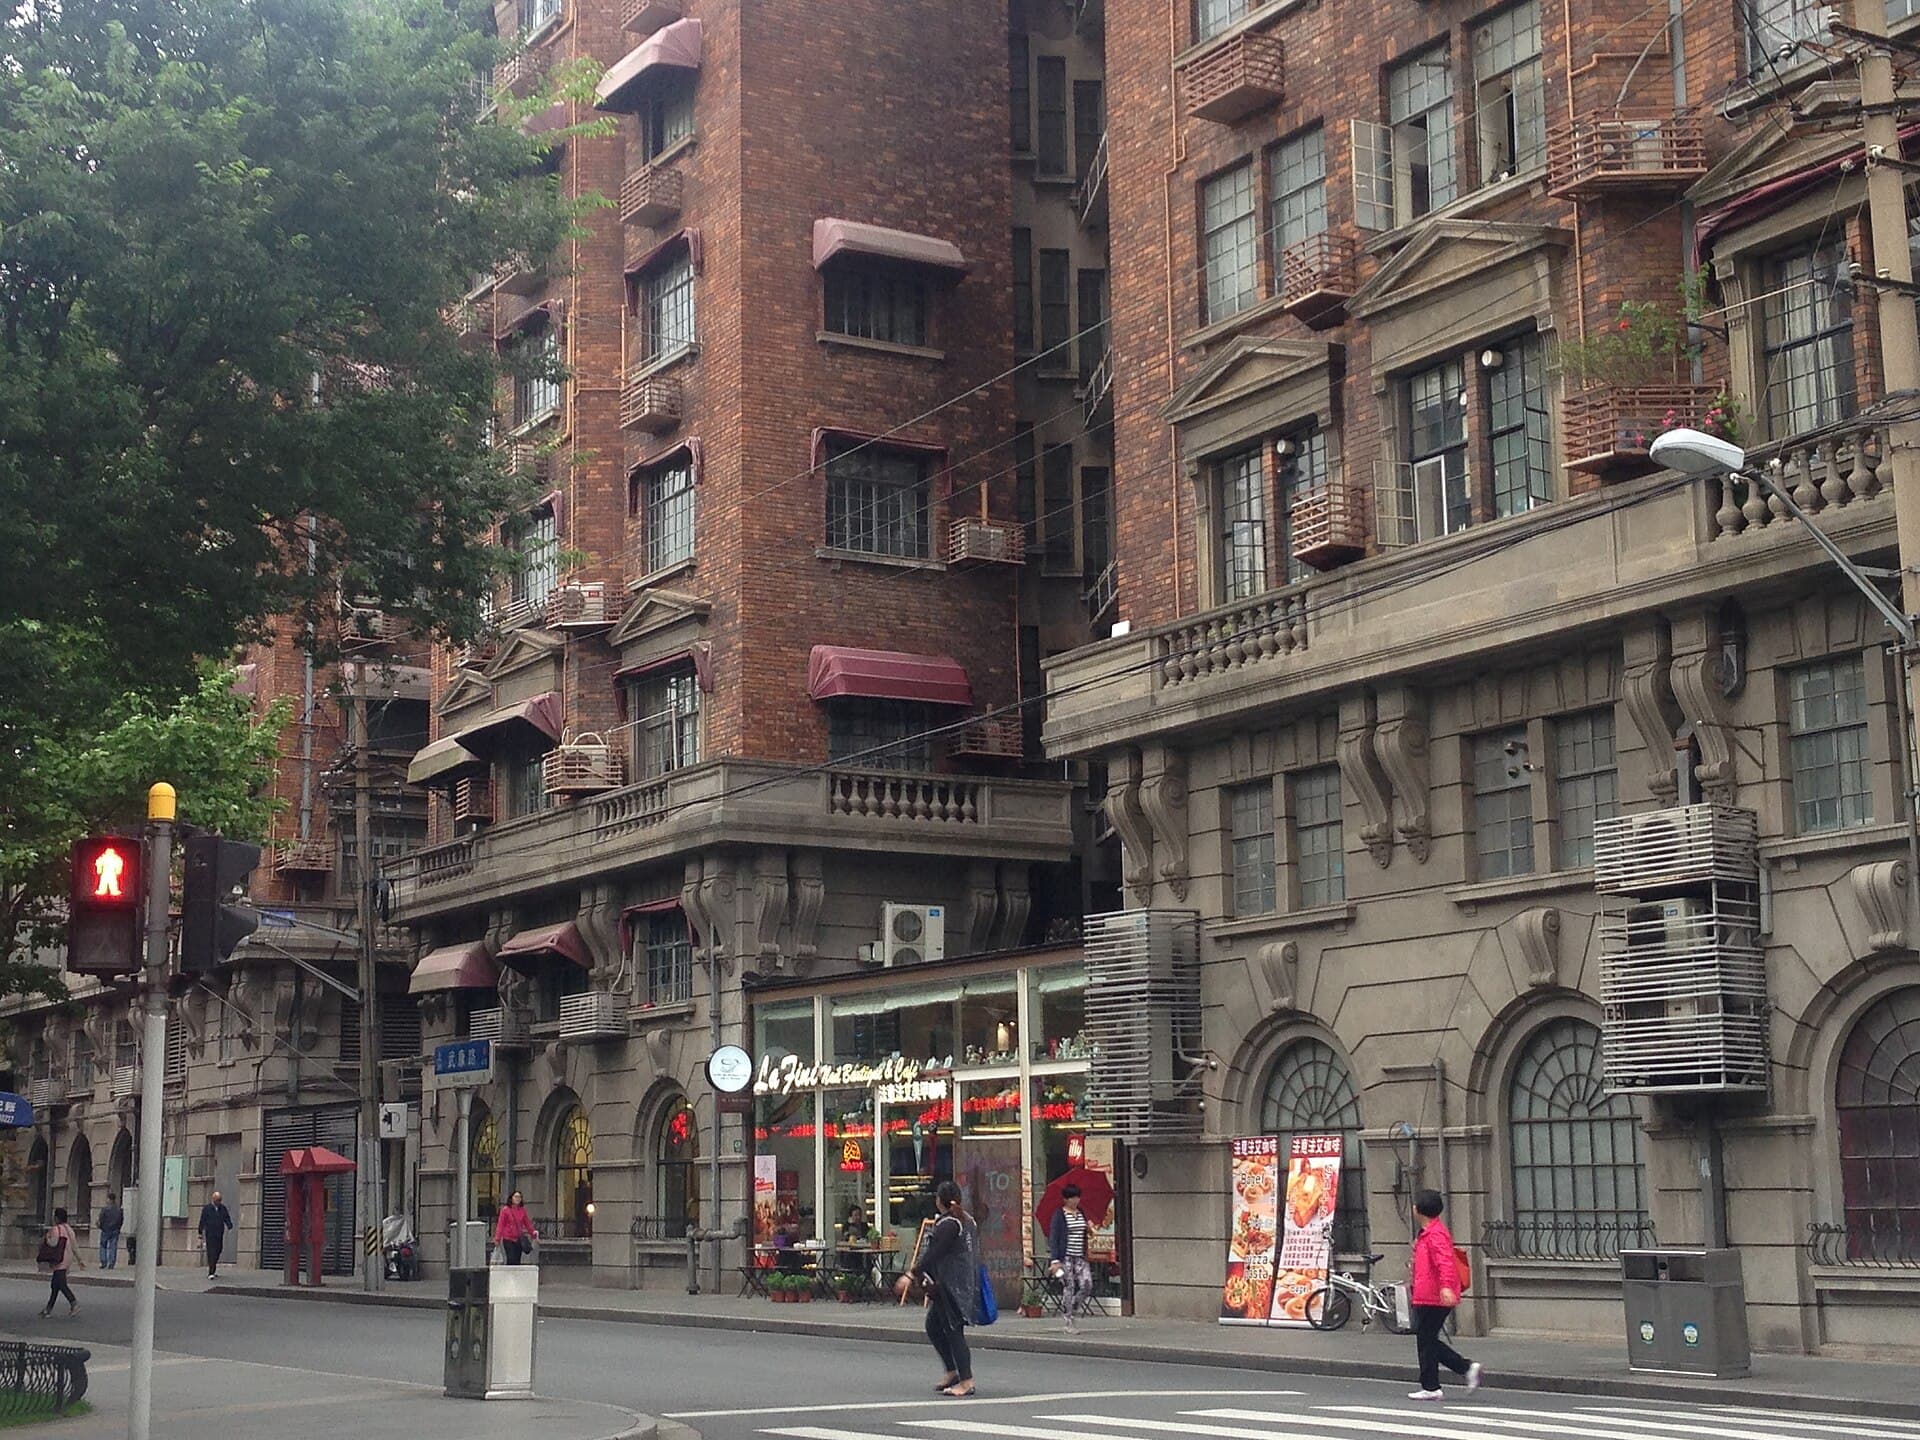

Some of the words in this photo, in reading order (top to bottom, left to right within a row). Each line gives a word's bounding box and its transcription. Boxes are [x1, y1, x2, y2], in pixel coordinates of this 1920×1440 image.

[753, 1054, 780, 1093] La
[884, 1058, 893, 1080] &
[1068, 1138, 1083, 1160] illy
[1240, 1172, 1264, 1187] Bagel
